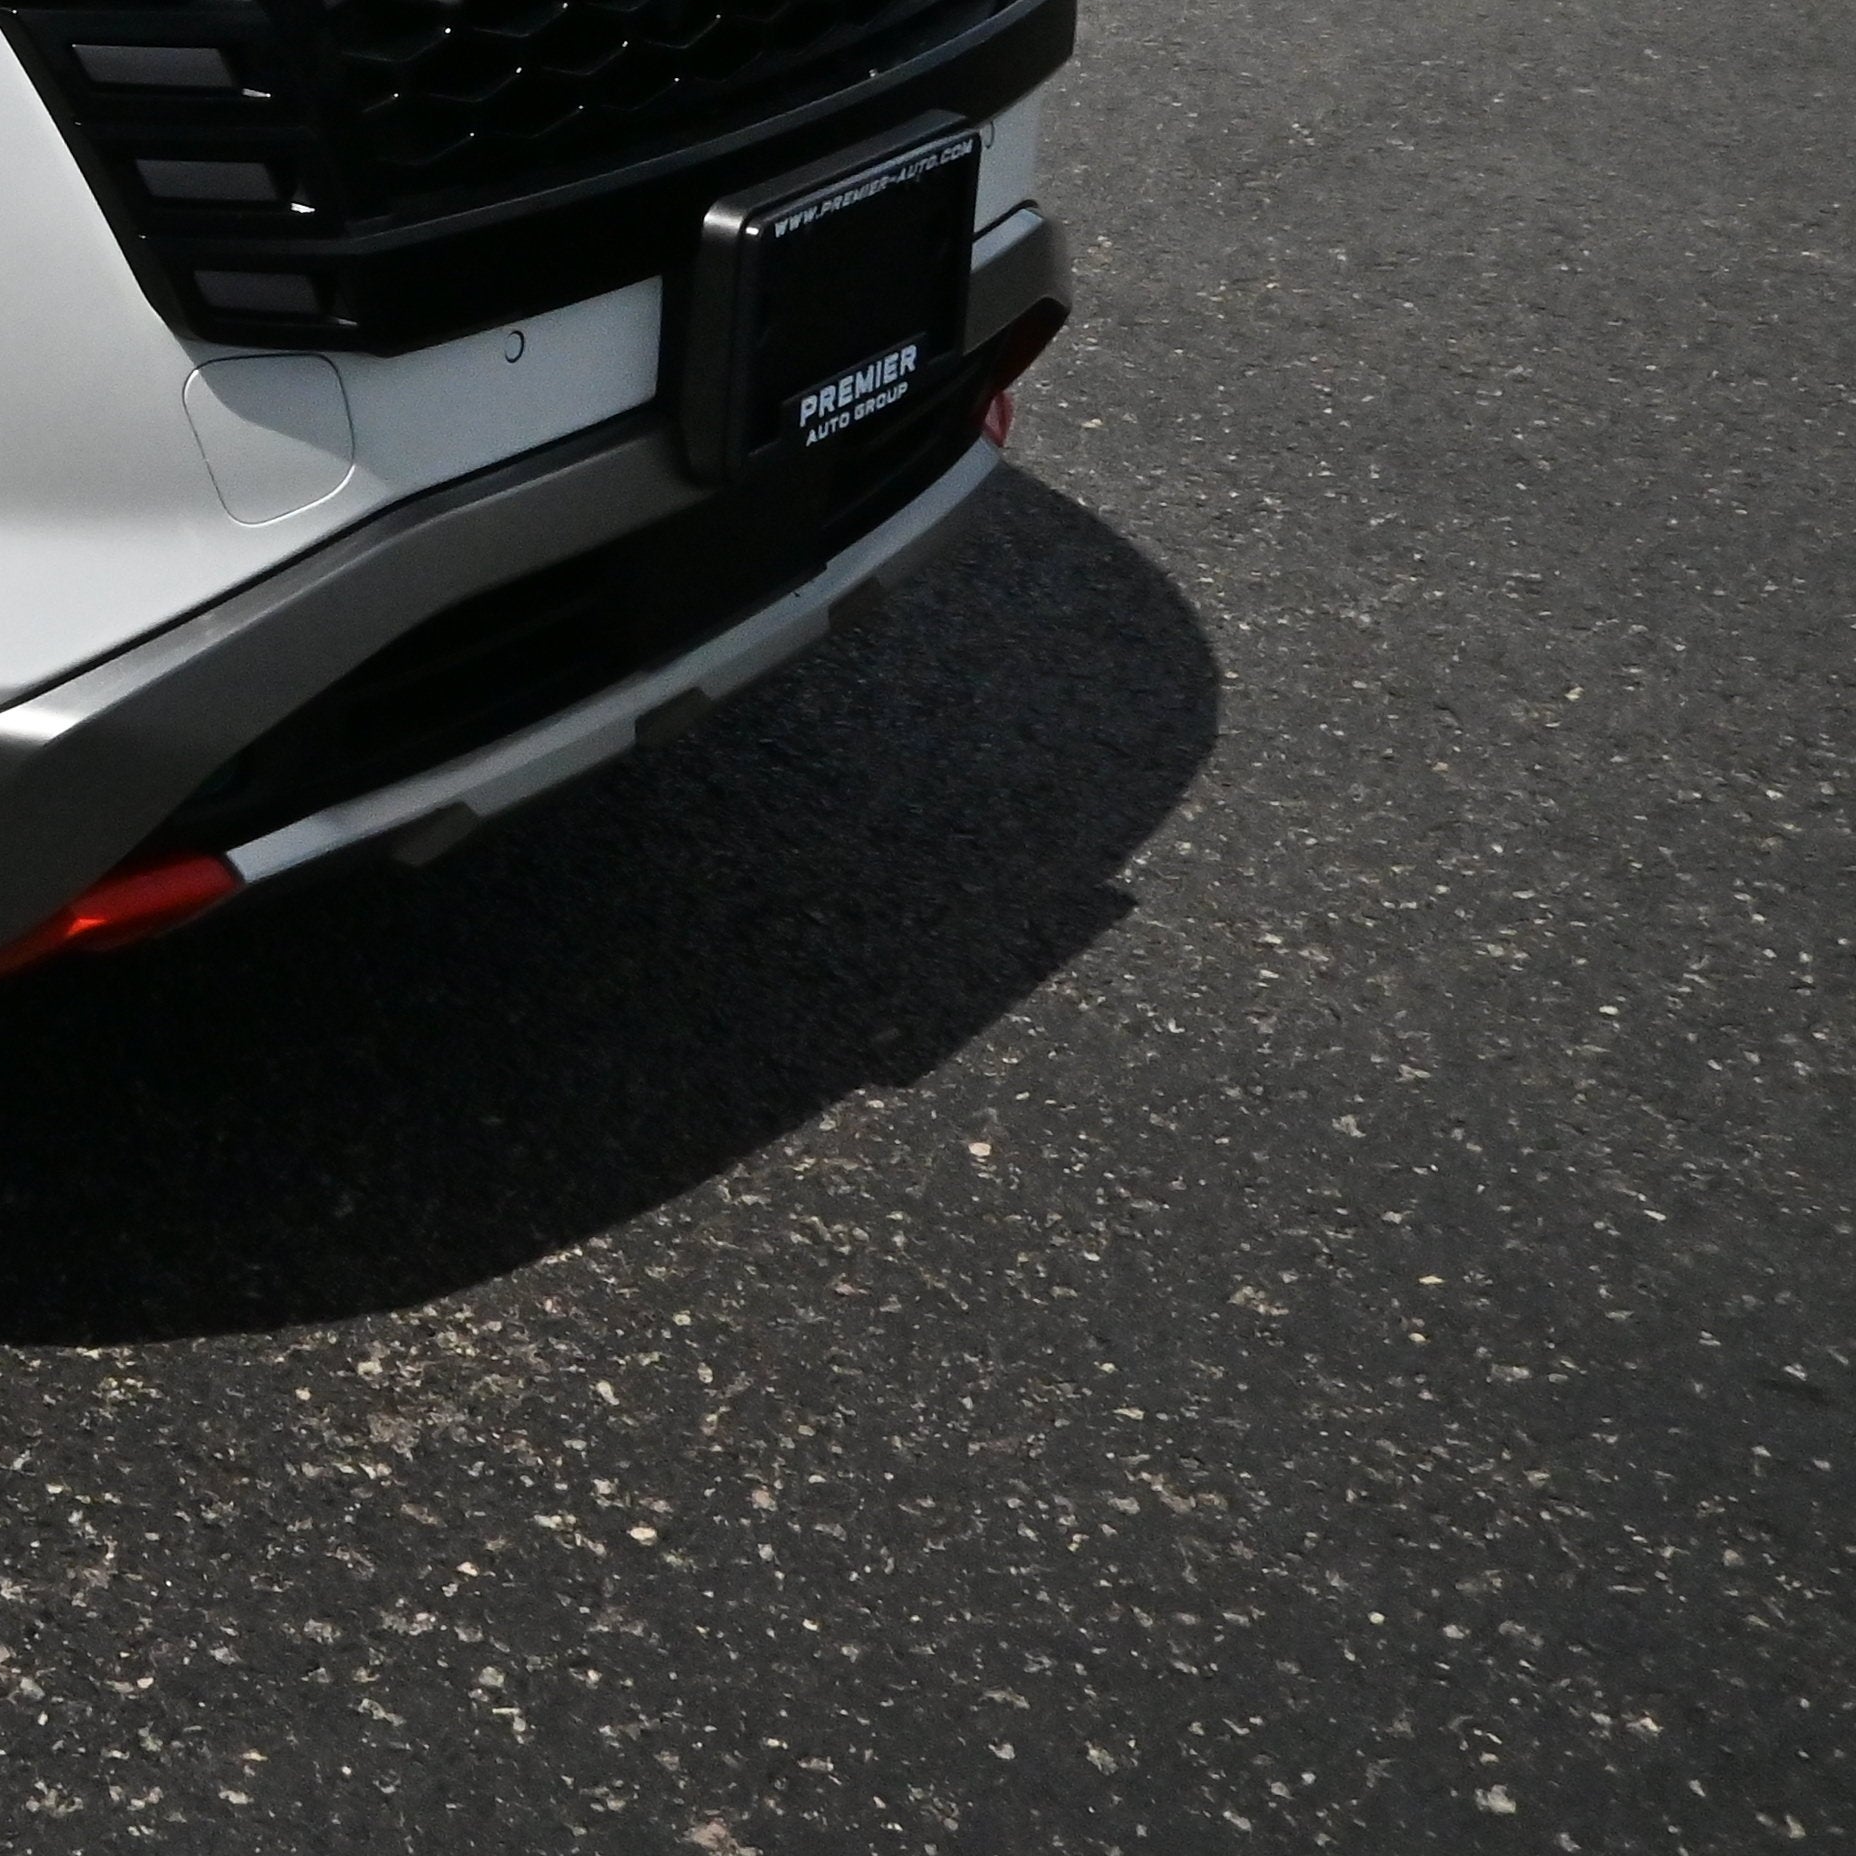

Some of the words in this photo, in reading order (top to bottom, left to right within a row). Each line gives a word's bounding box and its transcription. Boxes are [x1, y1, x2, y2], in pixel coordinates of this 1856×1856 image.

[799, 344, 918, 428] PREMIER
[805, 411, 851, 447] AUTO
[853, 381, 909, 421] GROUP
